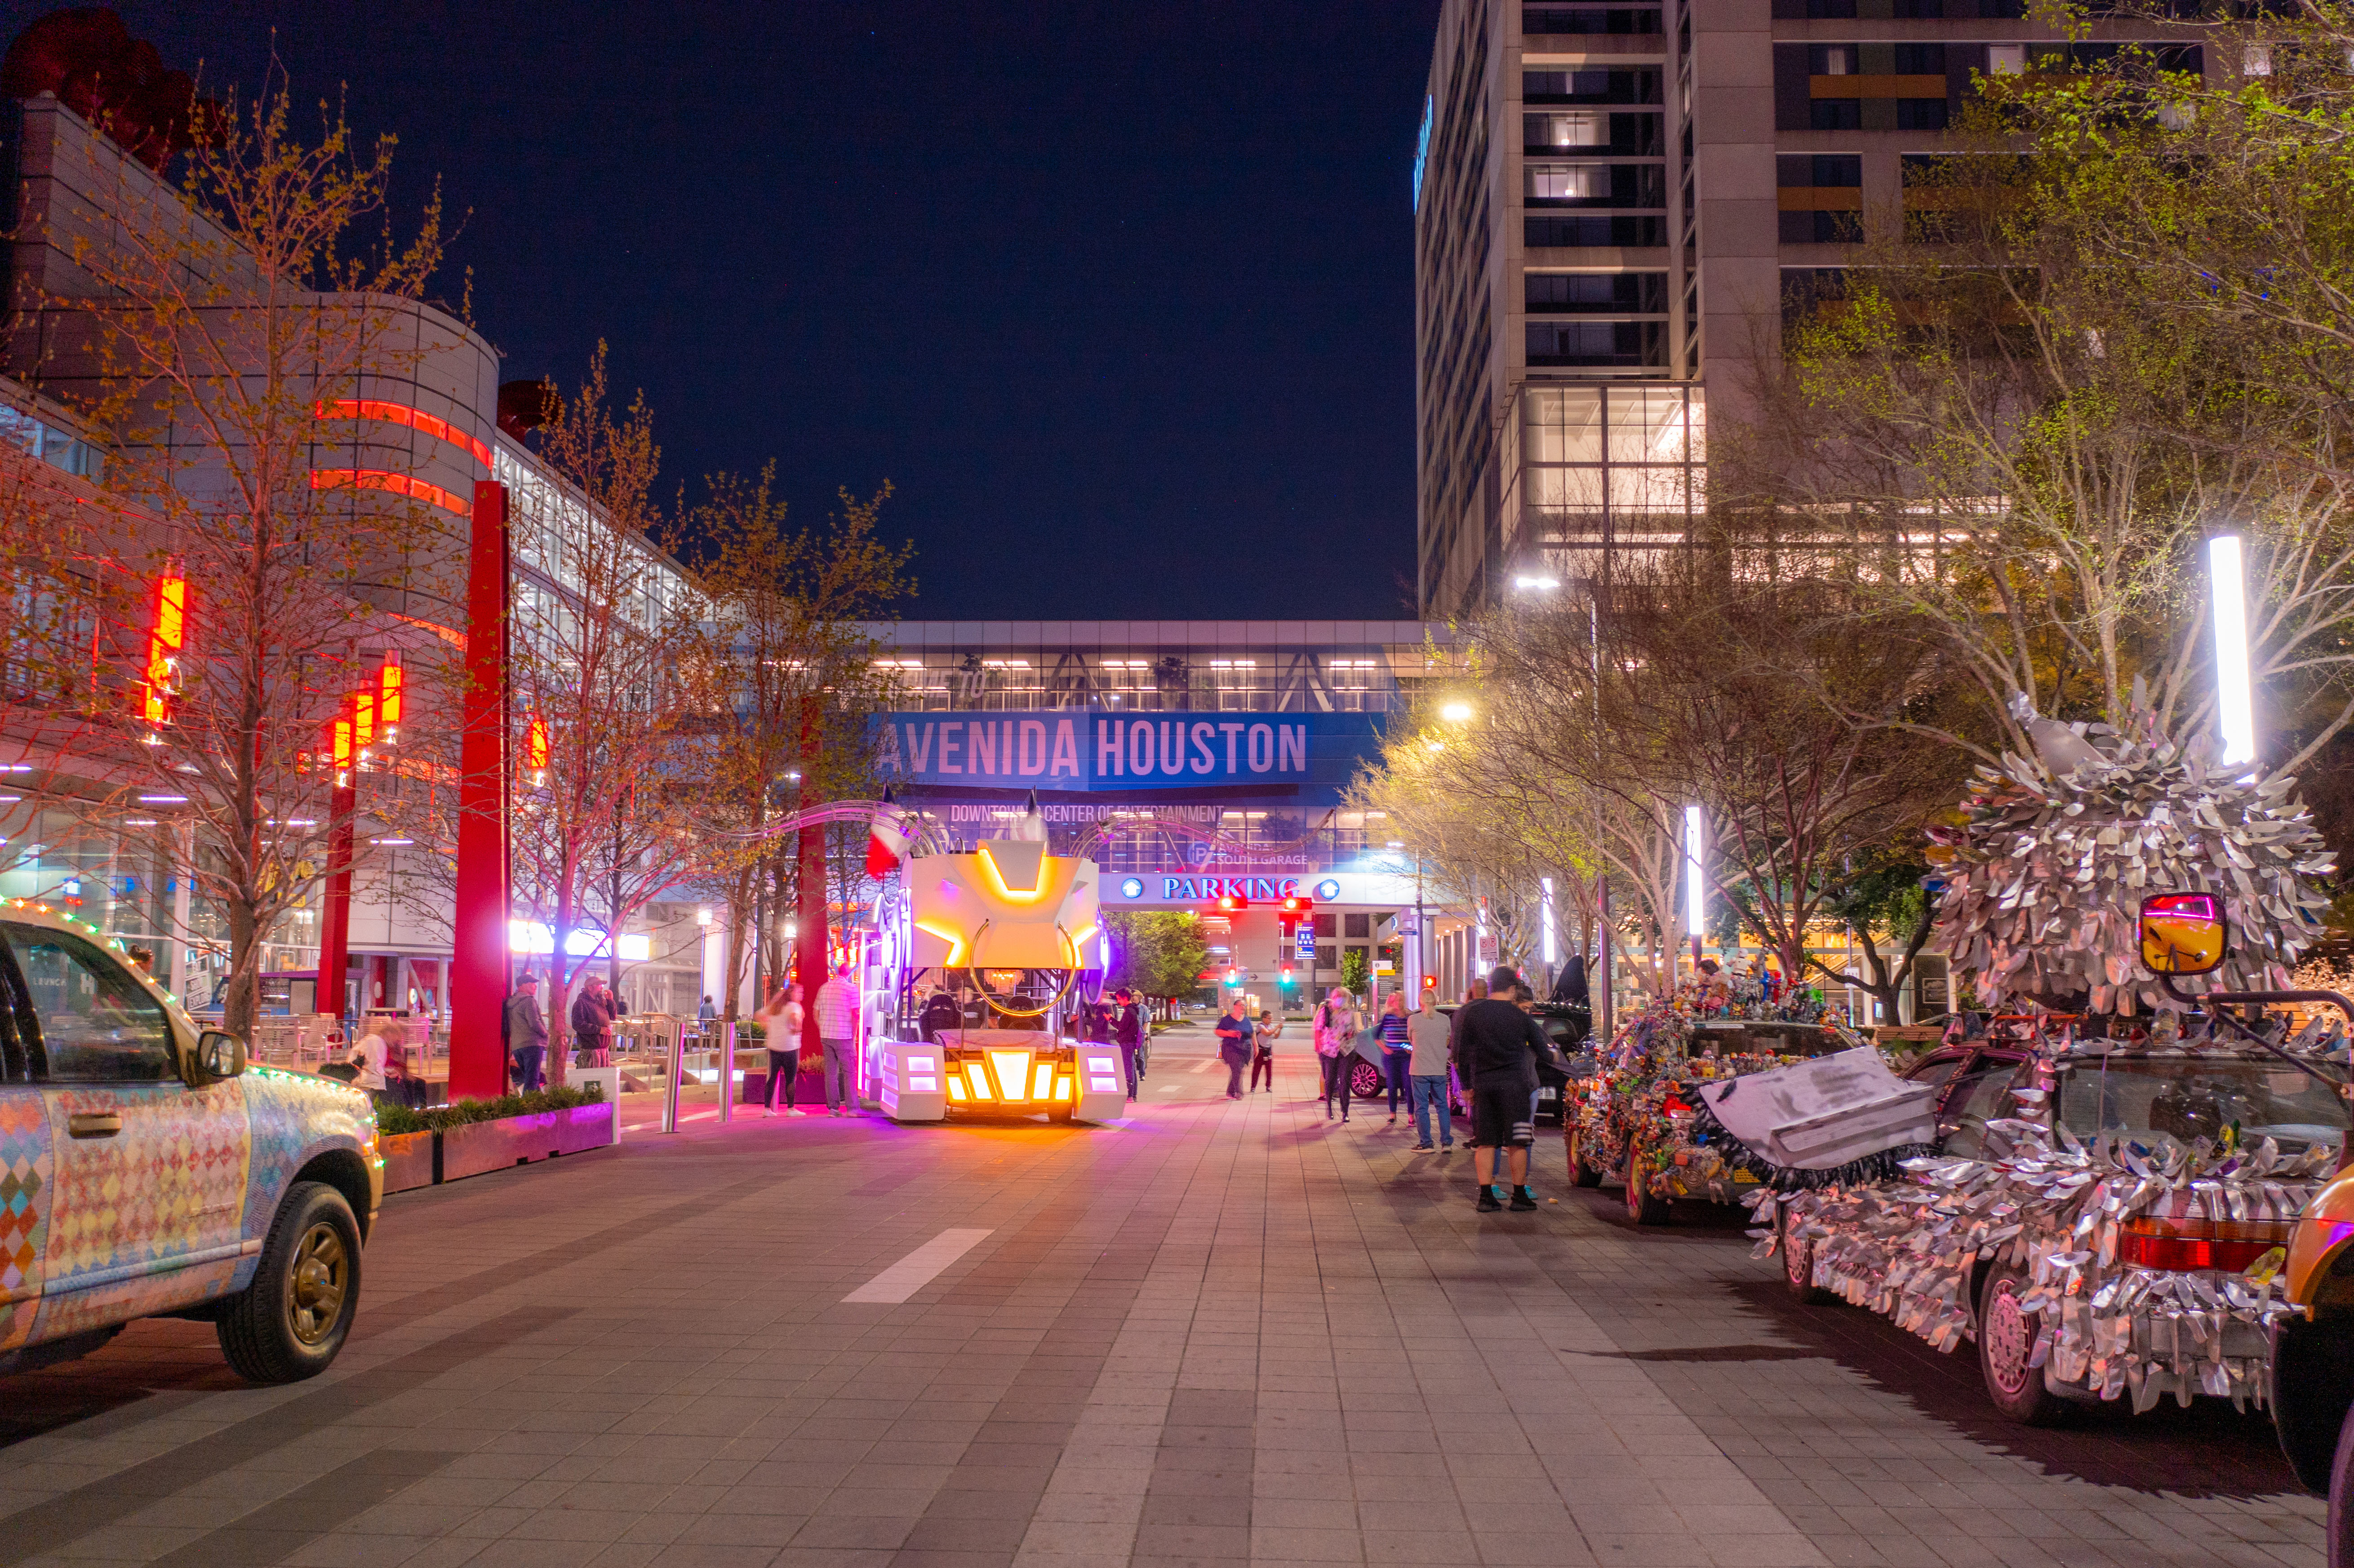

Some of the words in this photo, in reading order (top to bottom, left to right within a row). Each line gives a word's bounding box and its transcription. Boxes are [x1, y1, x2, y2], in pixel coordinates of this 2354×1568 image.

[959, 670, 987, 698] TO
[874, 719, 1079, 777] AVENIDA
[1097, 719, 1306, 776] HOUSTON
[951, 805, 1041, 822] DOWNTOWN
[1044, 805, 1094, 822] CENTER
[1097, 805, 1114, 822] OF
[1117, 805, 1224, 822] ENTERTAINMENT
[1217, 855, 1258, 865] SOUTH
[1261, 855, 1307, 865] GARAGE
[1163, 878, 1300, 899] PARKING
